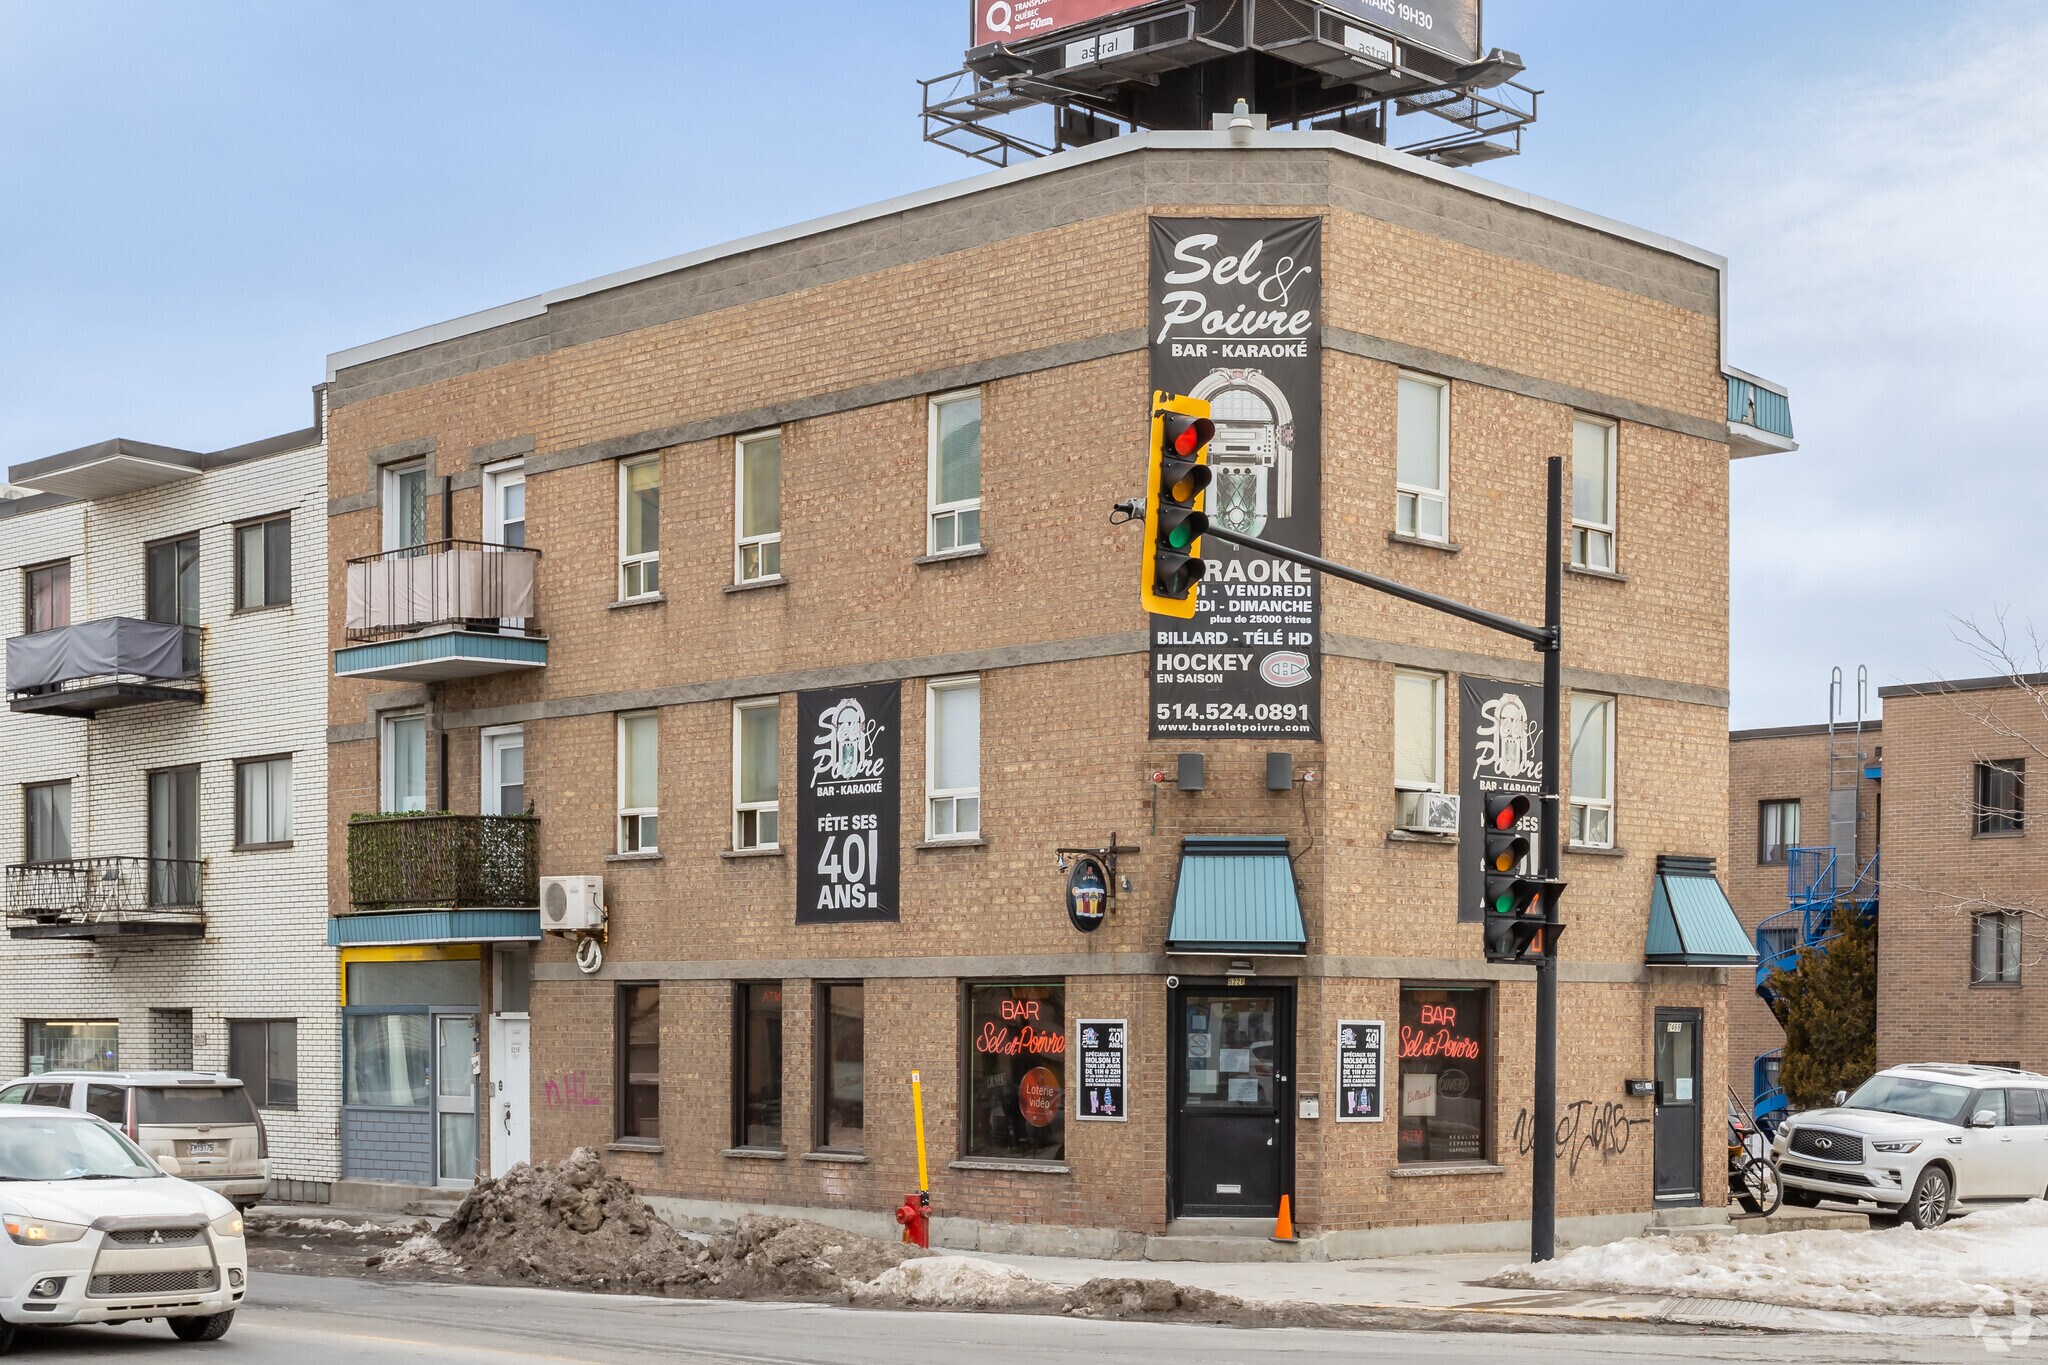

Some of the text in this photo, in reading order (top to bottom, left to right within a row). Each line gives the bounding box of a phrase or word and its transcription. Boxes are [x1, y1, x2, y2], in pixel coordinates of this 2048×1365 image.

[1014, 8, 1039, 22] QUÉBEC
[1398, 3, 1433, 30] 19H30
[1081, 37, 1118, 60] asral
[1164, 233, 1312, 307] Sel &
[1156, 290, 1312, 345] Poivre
[1171, 343, 1207, 357] BAR
[1222, 340, 1308, 358] KARAOKÉ
[1199, 559, 1312, 583] RAOKE
[1224, 584, 1312, 597] VENDREDI
[1228, 600, 1312, 612] DIMANCHE
[1209, 614, 1312, 625] plus de 25000 titres
[1157, 631, 1228, 645] BILLARD
[1243, 629, 1283, 646] TÉLÉ
[1288, 632, 1313, 646] HD
[1156, 653, 1254, 671] HOCKEY
[1156, 673, 1223, 683] EN SAISON
[1157, 703, 1309, 721] 514.524.0891
[1157, 722, 1310, 733] www.barseletpoivre.com
[817, 786, 835, 797] BAR
[840, 781, 882, 795] KARAOKÉ
[1480, 780, 1497, 791] BAR
[817, 813, 878, 832] FÊTE SES
[1001, 1000, 1040, 1021] BAR
[1421, 1005, 1456, 1027] BAR
[976, 1022, 1008, 1054] Sel
[1018, 1025, 1066, 1054] Poivre
[1399, 1025, 1479, 1059] Sel et Poivre
[1026, 1084, 1054, 1097] Loterie
[1440, 1078, 1466, 1091] OUVERT
[1029, 1097, 1050, 1109] vidéo
[1407, 1085, 1432, 1104] Billard
[1402, 1129, 1423, 1143] ATM
